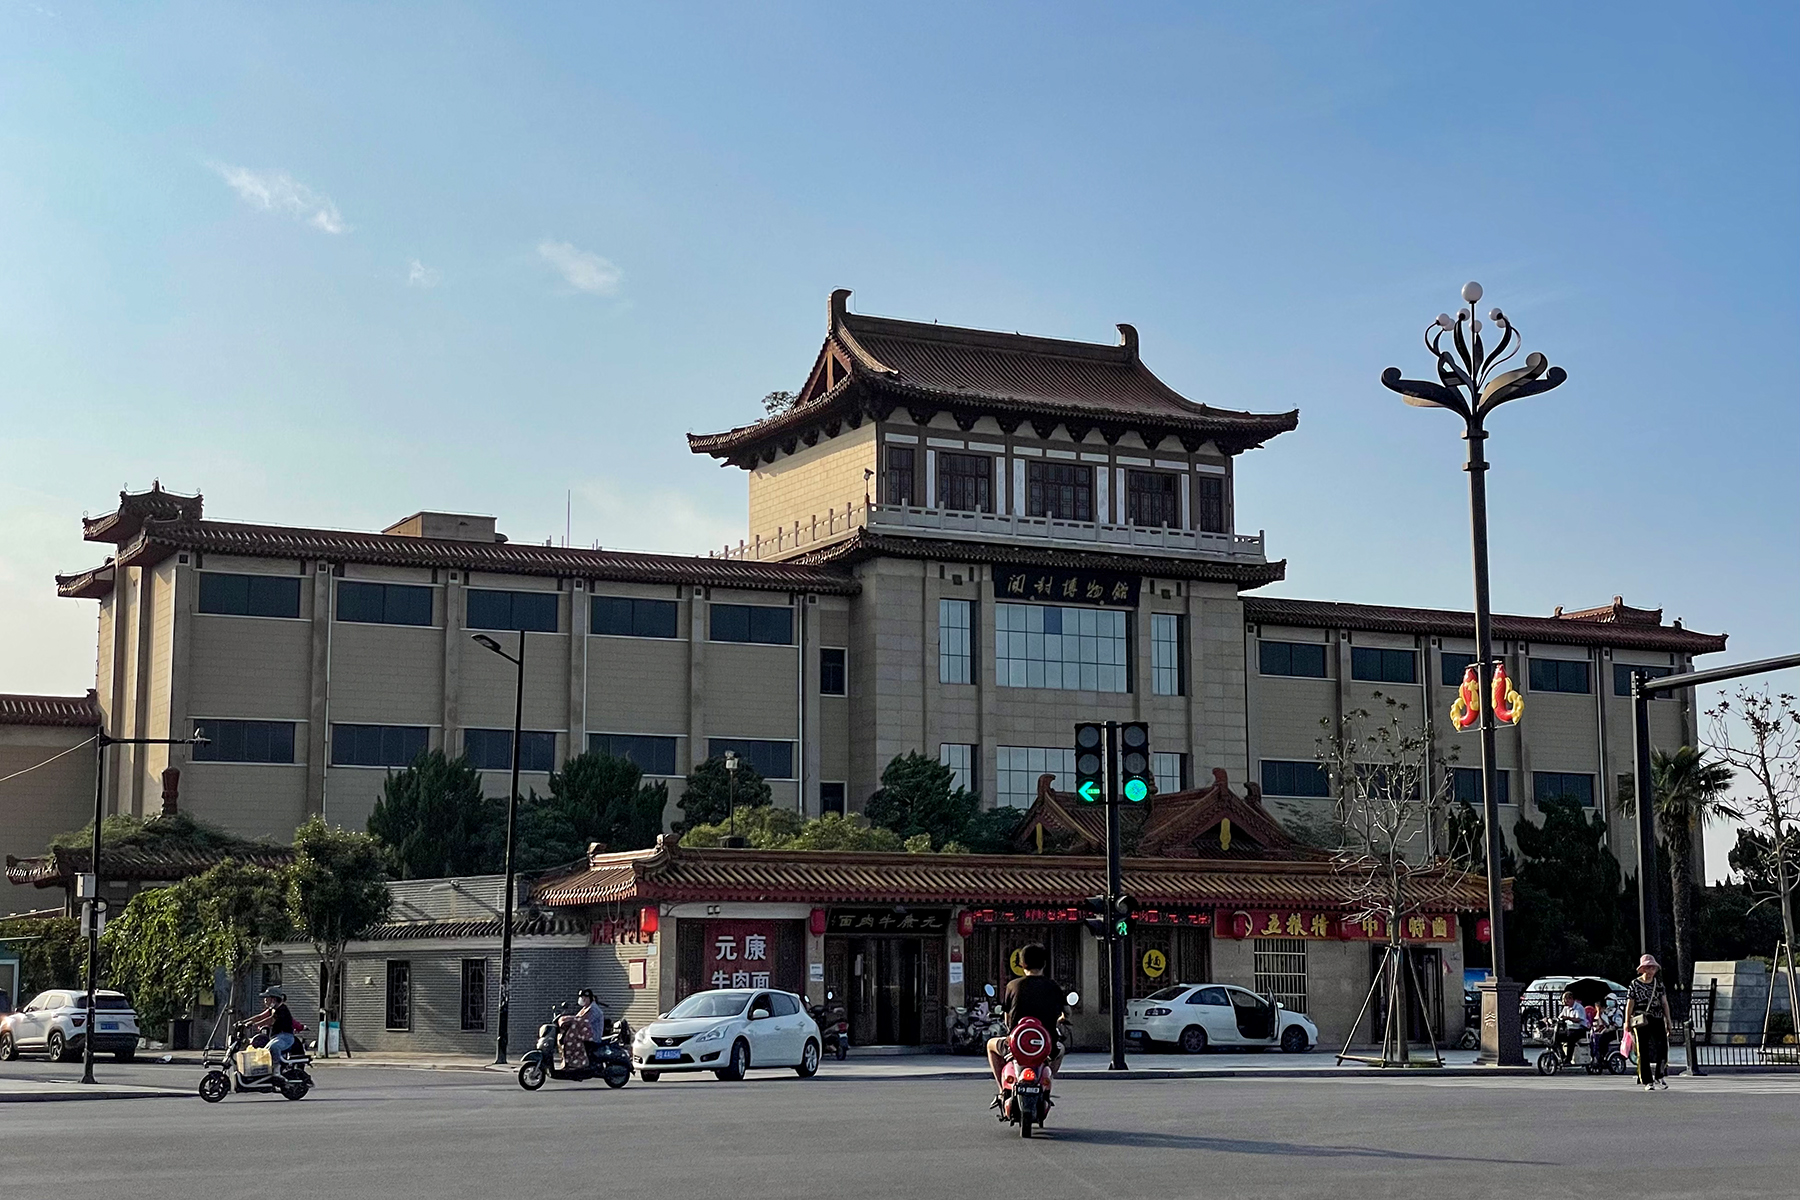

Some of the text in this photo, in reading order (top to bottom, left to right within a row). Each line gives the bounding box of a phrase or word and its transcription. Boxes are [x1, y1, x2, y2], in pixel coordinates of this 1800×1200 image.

[715, 933, 767, 961] 元康
[711, 969, 771, 989] 牛肉面
